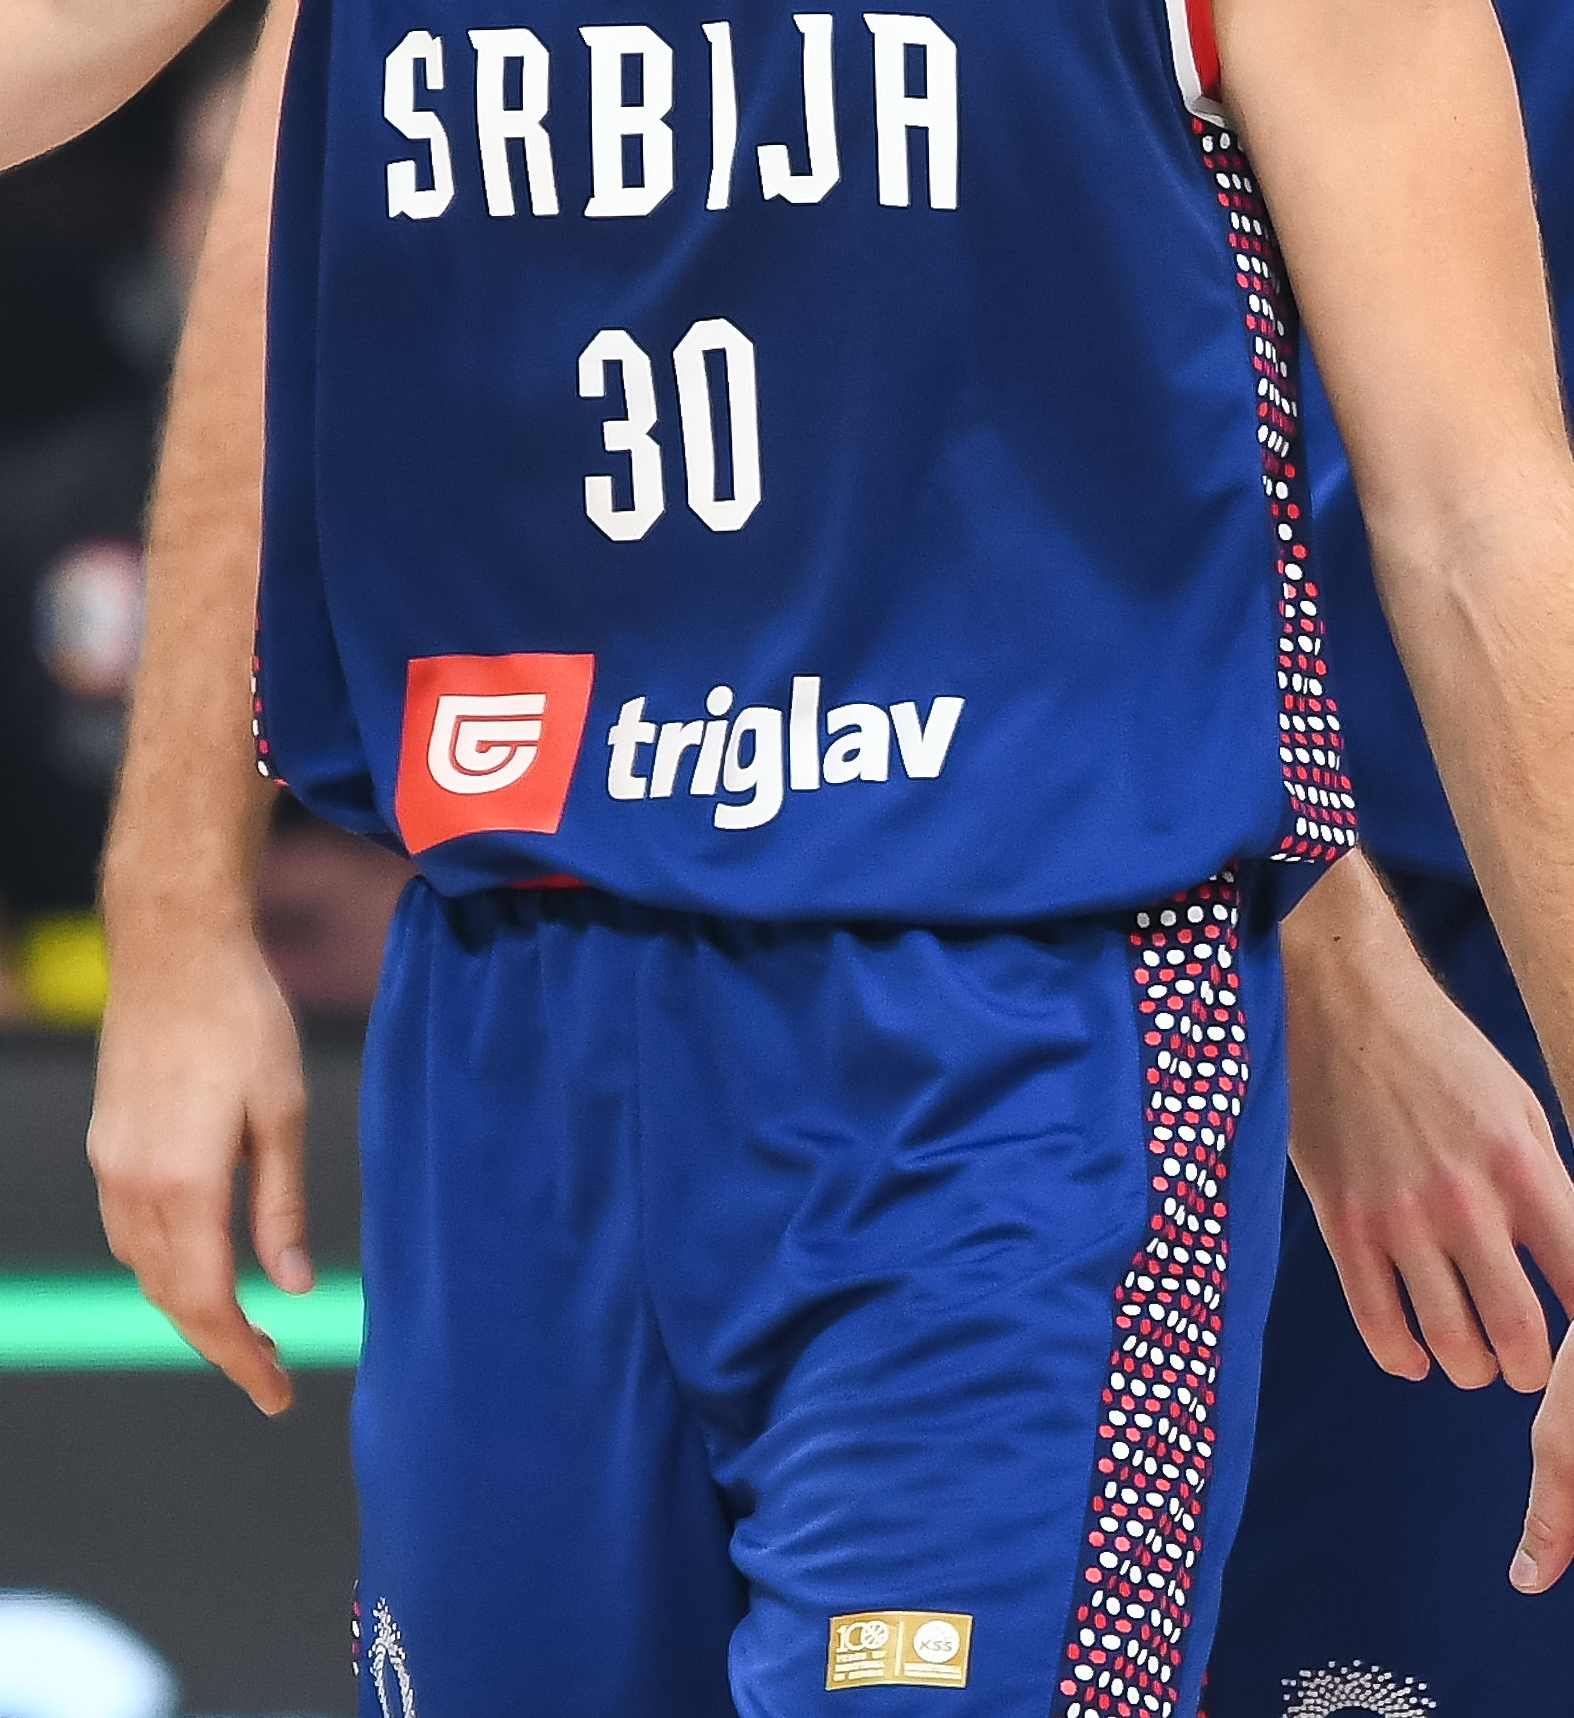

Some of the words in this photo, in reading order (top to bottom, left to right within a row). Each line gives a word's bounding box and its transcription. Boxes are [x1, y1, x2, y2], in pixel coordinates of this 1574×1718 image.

[383, 12, 958, 220] SRBIJA
[577, 317, 762, 542] 30
[607, 676, 965, 830] triglav
